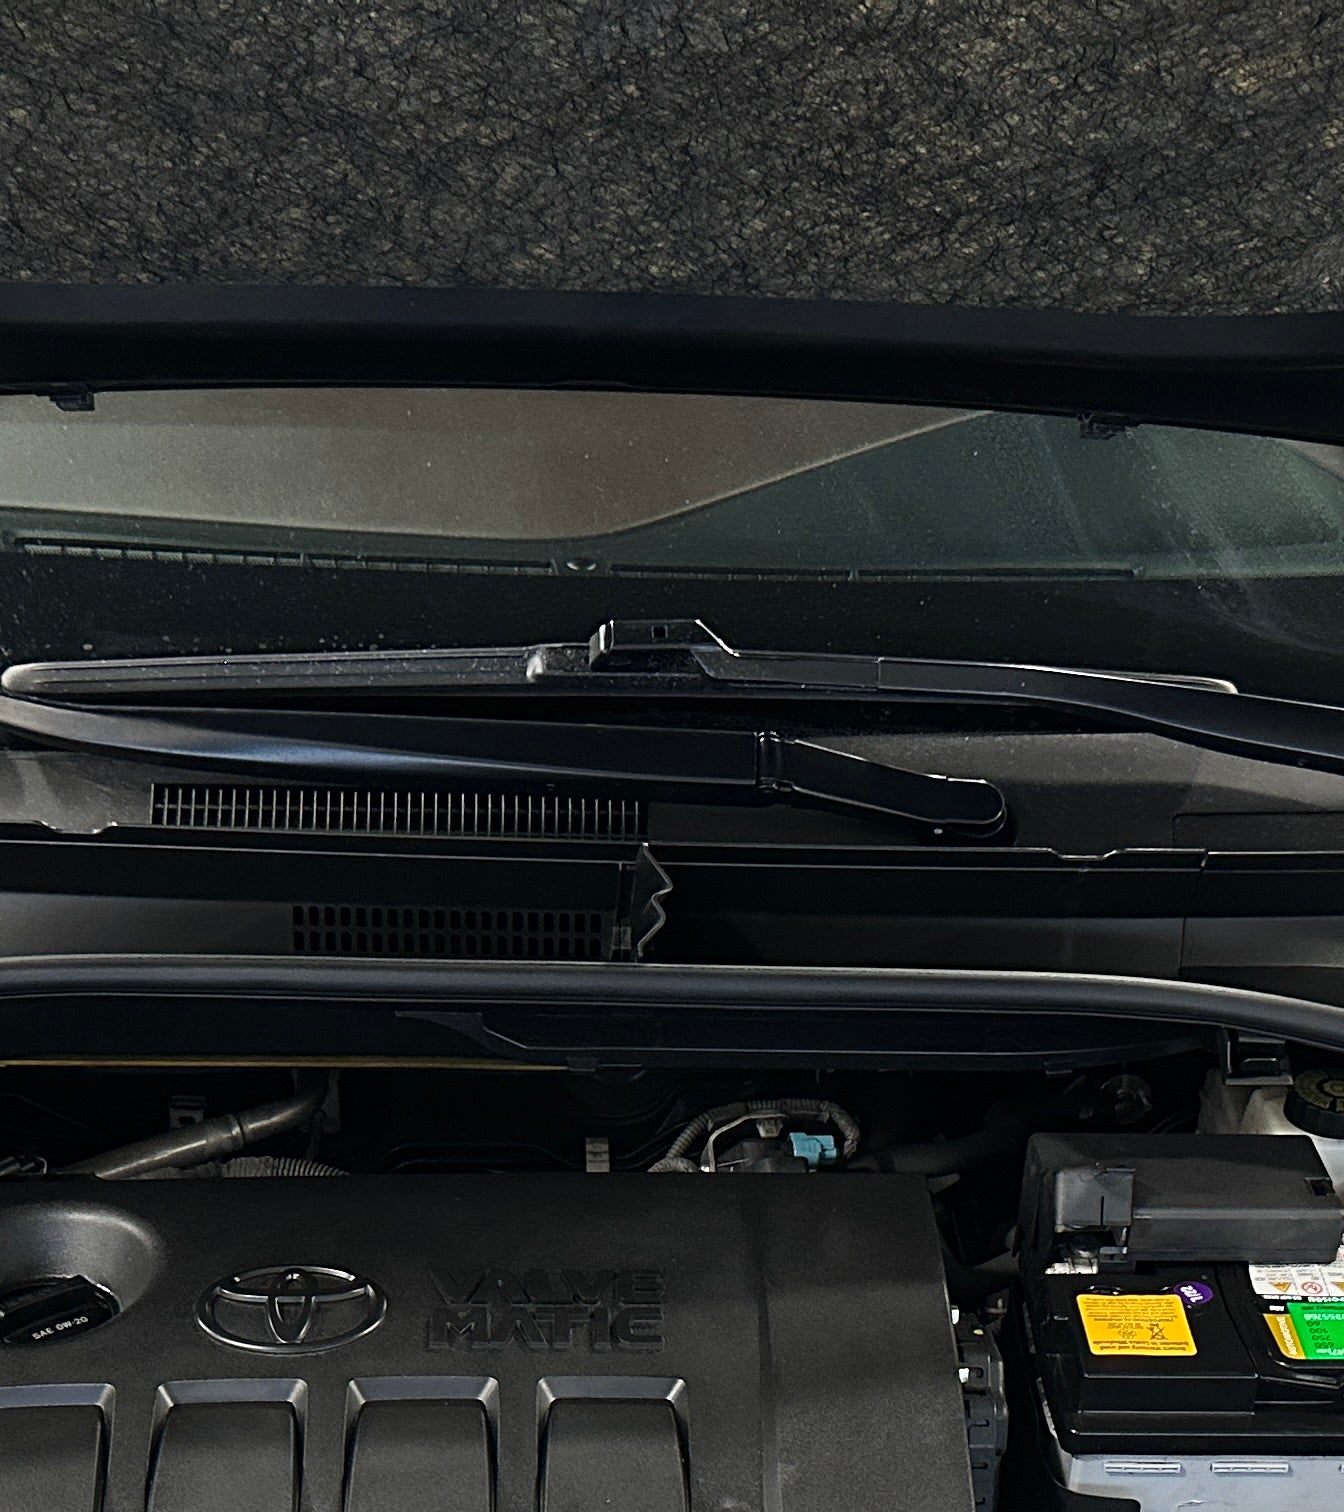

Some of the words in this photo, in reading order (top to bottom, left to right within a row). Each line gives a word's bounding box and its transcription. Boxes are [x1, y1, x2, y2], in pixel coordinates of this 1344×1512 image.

[426, 1267, 666, 1306] VALVE
[1179, 1284, 1204, 1304] 1/22
[31, 1326, 55, 1341] SAE
[55, 1315, 90, 1331] 0W-20
[426, 1303, 666, 1353] MATIC
[1305, 1320, 1321, 1328] 60
[1314, 1341, 1335, 1349] 650
